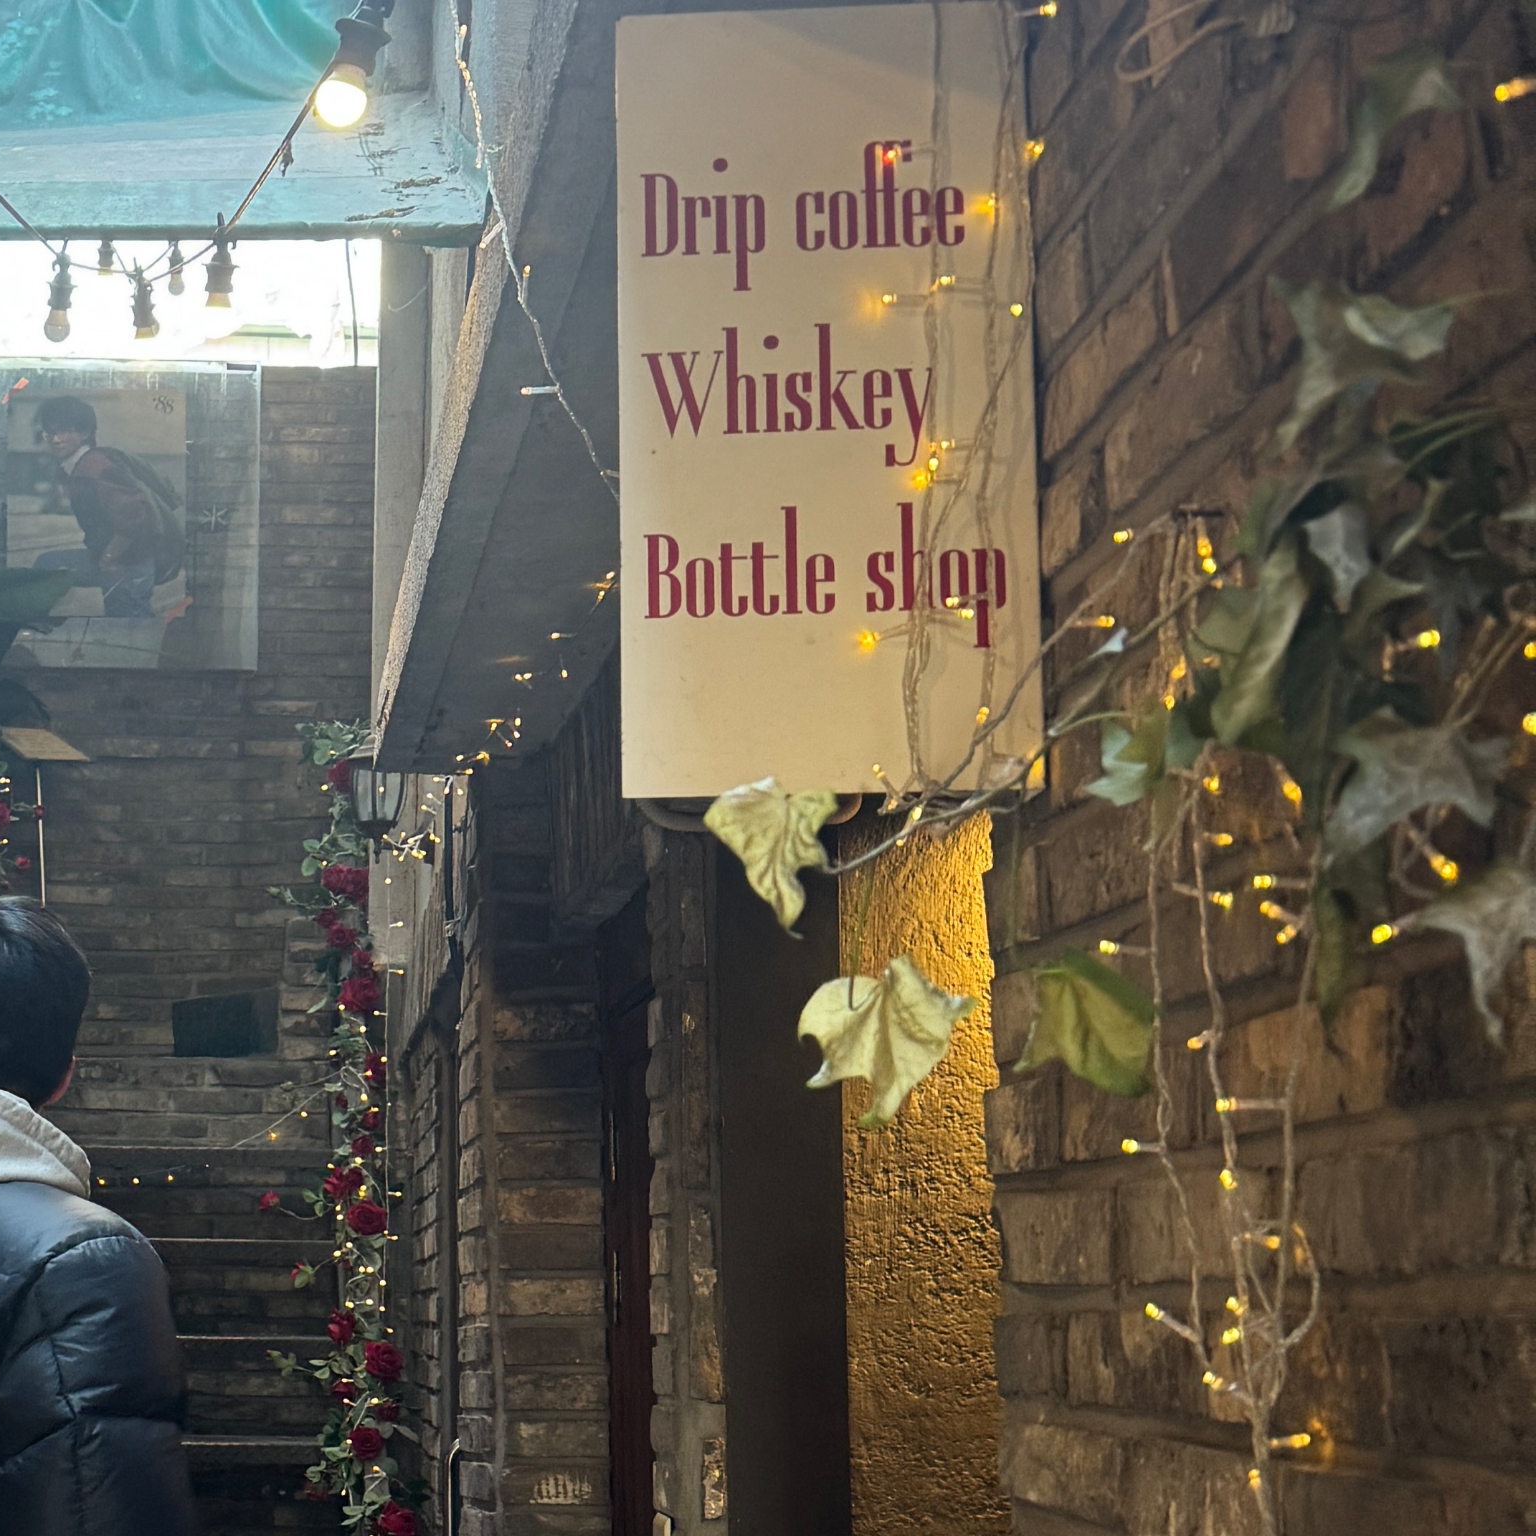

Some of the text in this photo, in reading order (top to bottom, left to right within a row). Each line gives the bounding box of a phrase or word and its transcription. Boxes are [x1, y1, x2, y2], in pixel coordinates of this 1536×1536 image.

[640, 140, 966, 292] Drip coffee
[641, 323, 935, 467] Whiskey
[642, 502, 1008, 649] Bottle shop
